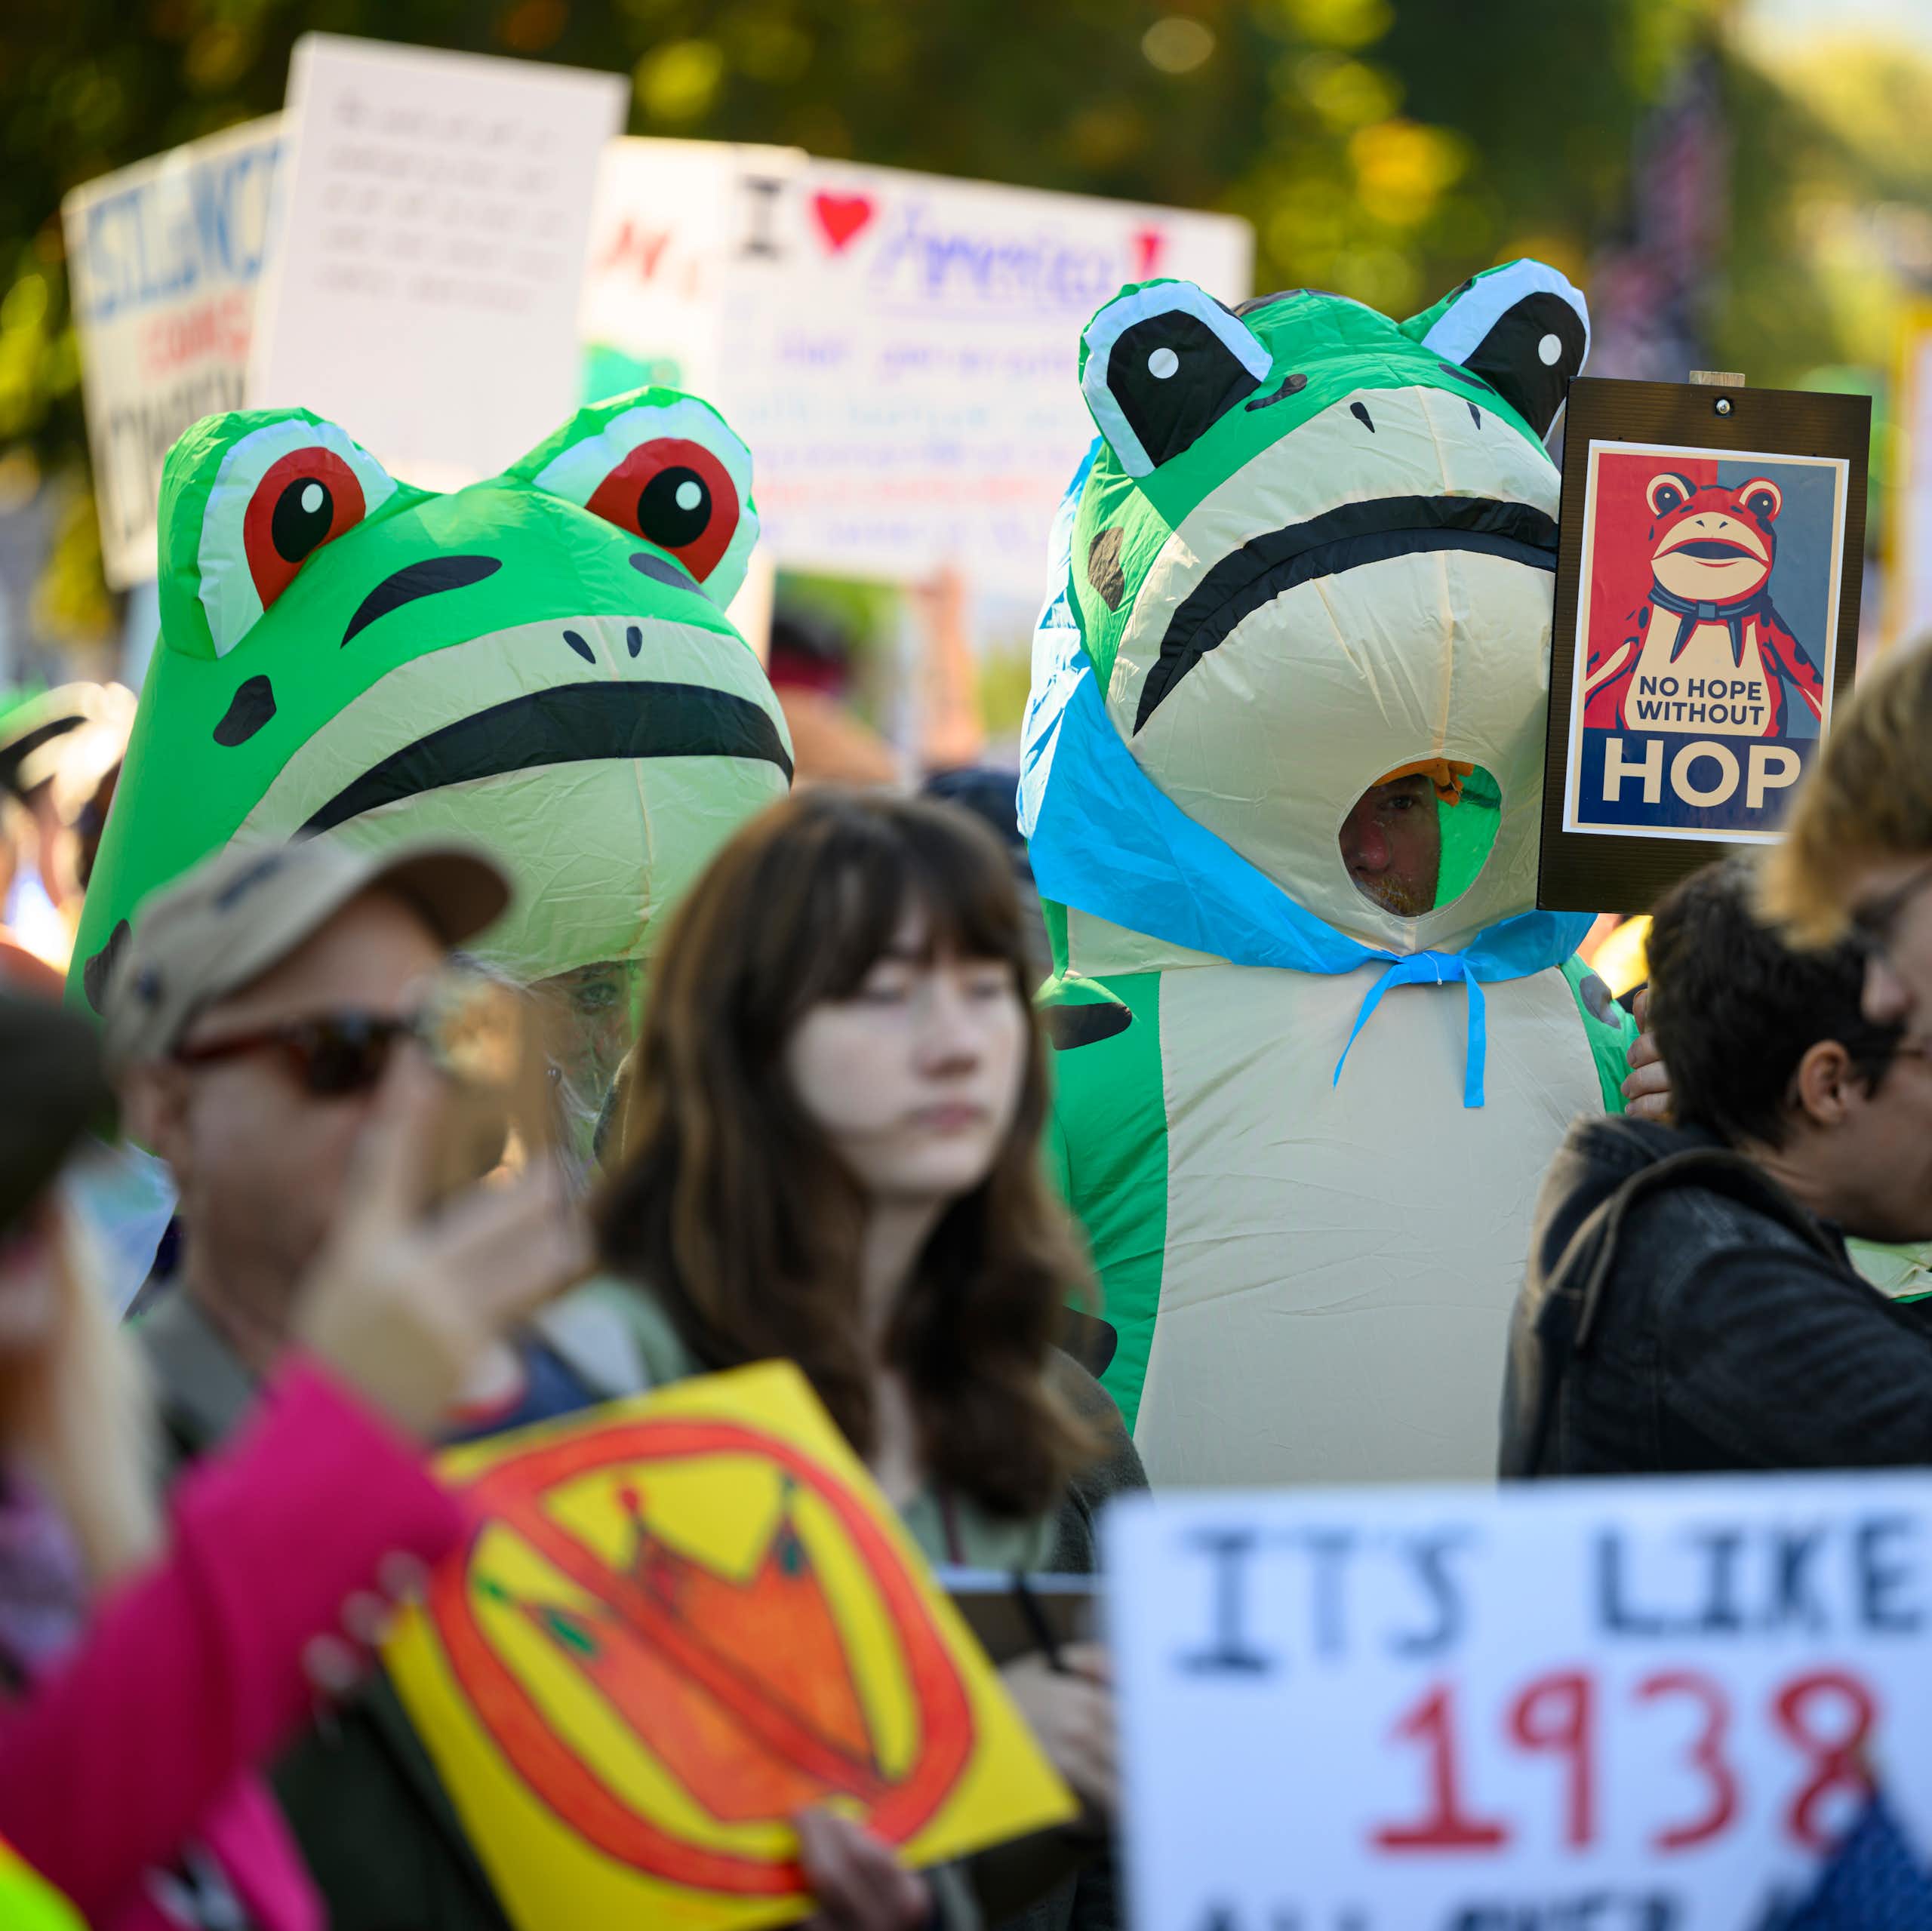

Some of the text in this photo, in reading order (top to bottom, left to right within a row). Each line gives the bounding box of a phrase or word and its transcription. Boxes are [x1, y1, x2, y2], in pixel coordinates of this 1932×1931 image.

[1637, 700, 1764, 725] WITHOUT
[1639, 675, 1762, 701] NO HOPE
[1602, 736, 1801, 809] HOP
[1592, 1511, 1926, 1637] LIKE
[1367, 1663, 1881, 1855] 1938
